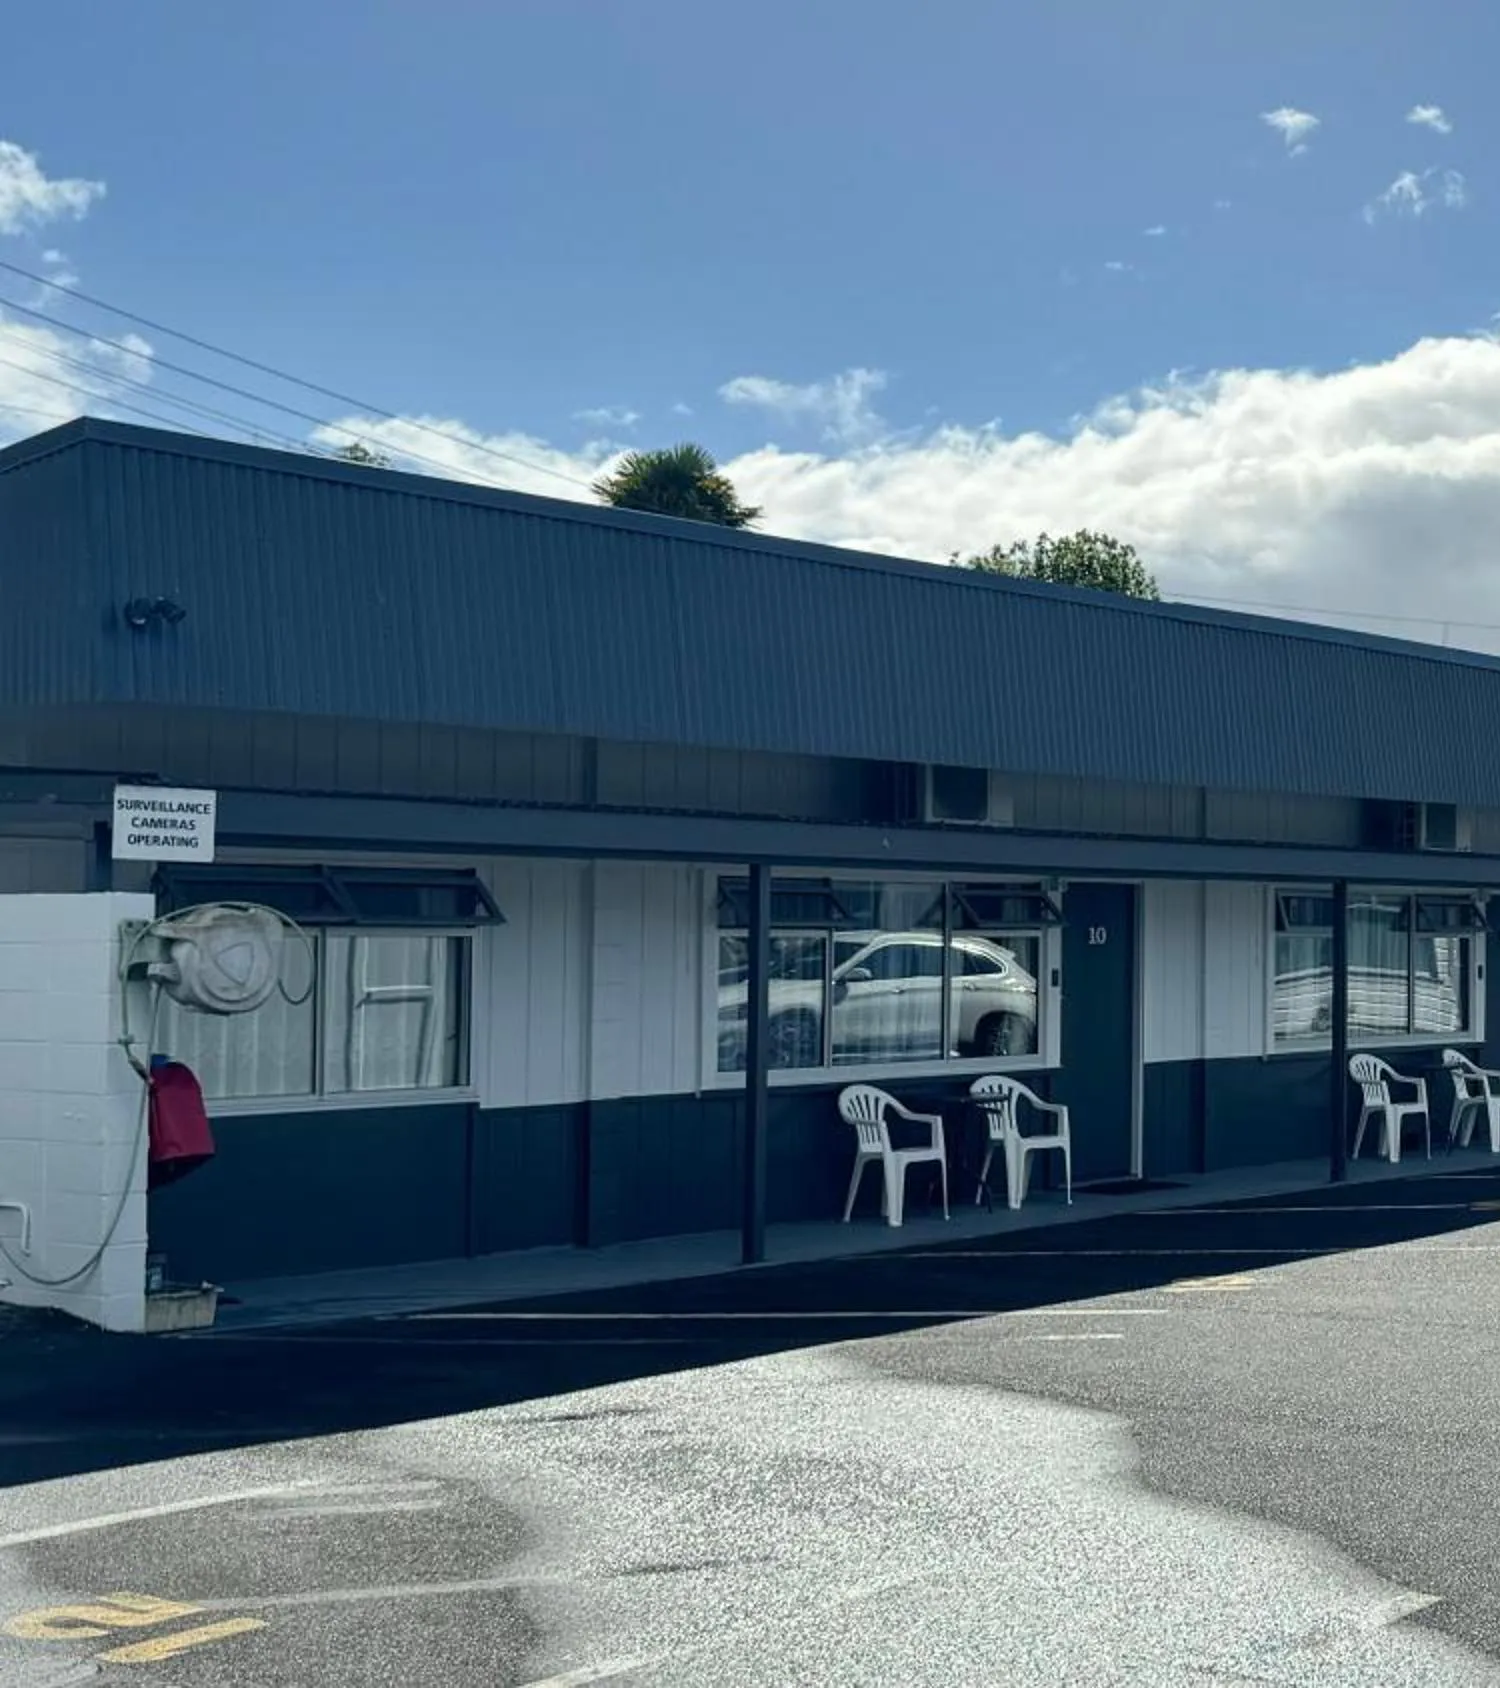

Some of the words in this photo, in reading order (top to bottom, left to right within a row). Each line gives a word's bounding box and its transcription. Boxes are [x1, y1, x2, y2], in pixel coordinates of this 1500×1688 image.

[117, 798, 212, 815] SURVEILLANCE
[131, 817, 197, 830] CAMERAS
[127, 833, 199, 848] OPERATING
[1088, 927, 1107, 944] 10
